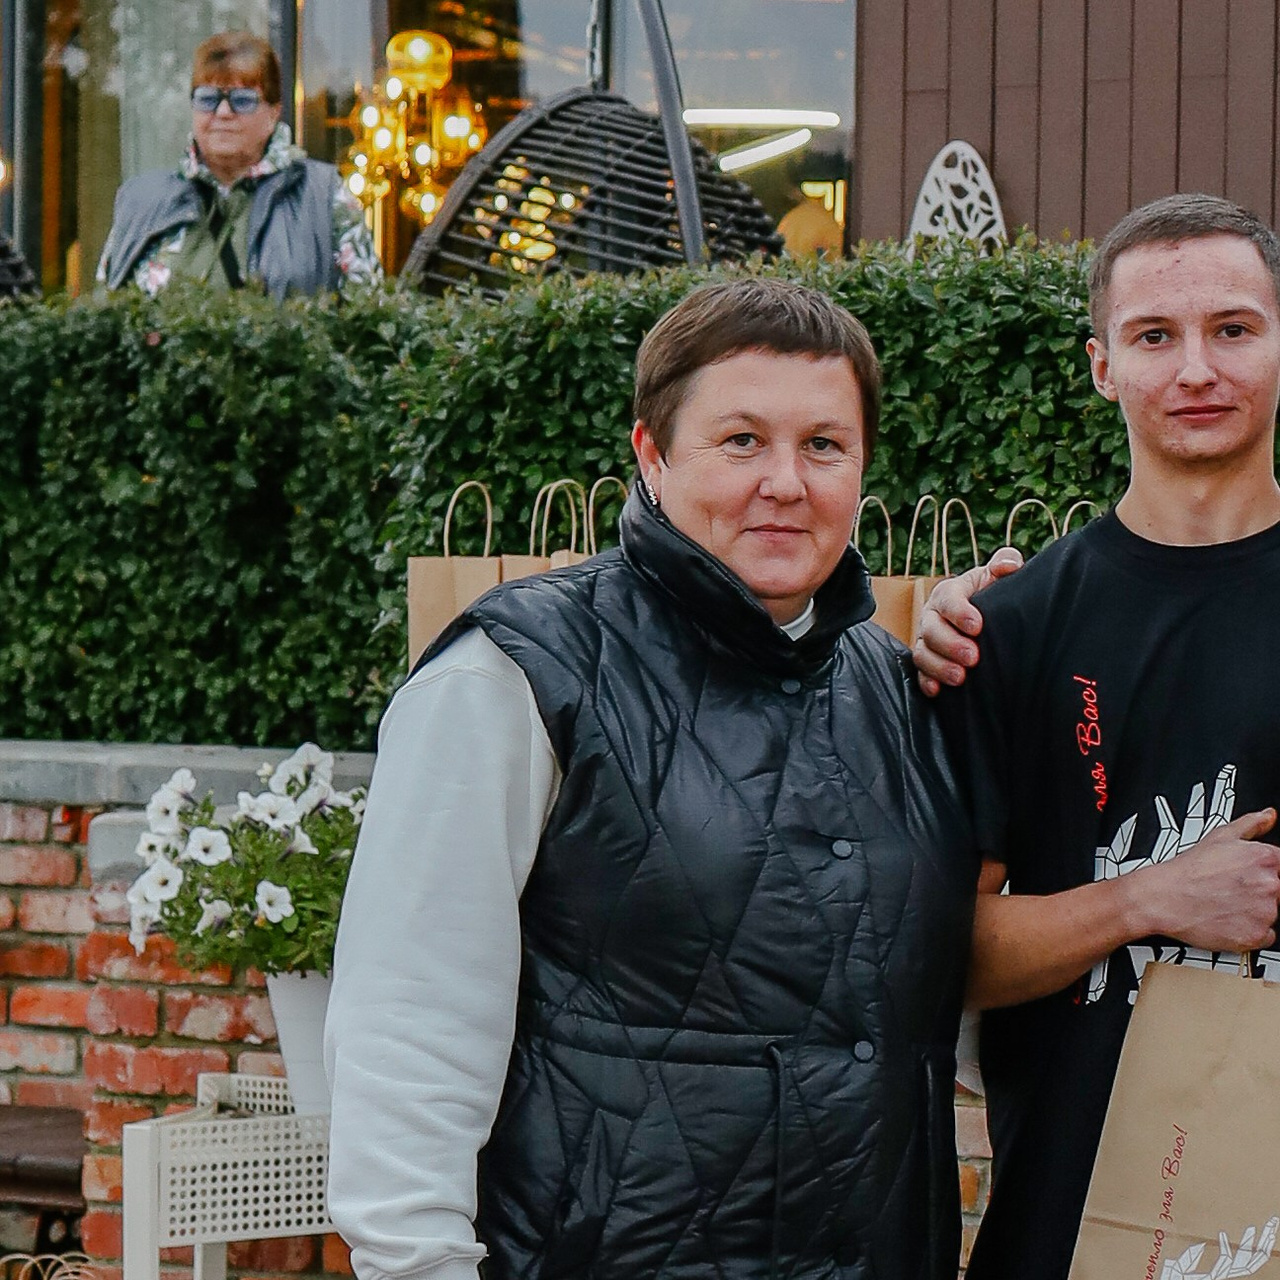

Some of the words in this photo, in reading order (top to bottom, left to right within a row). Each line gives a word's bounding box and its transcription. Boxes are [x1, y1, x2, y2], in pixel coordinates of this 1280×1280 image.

[1073, 675, 1101, 755] Вас!
[1161, 1123, 1188, 1180] Вас!
[1159, 1186, 1174, 1223] для
